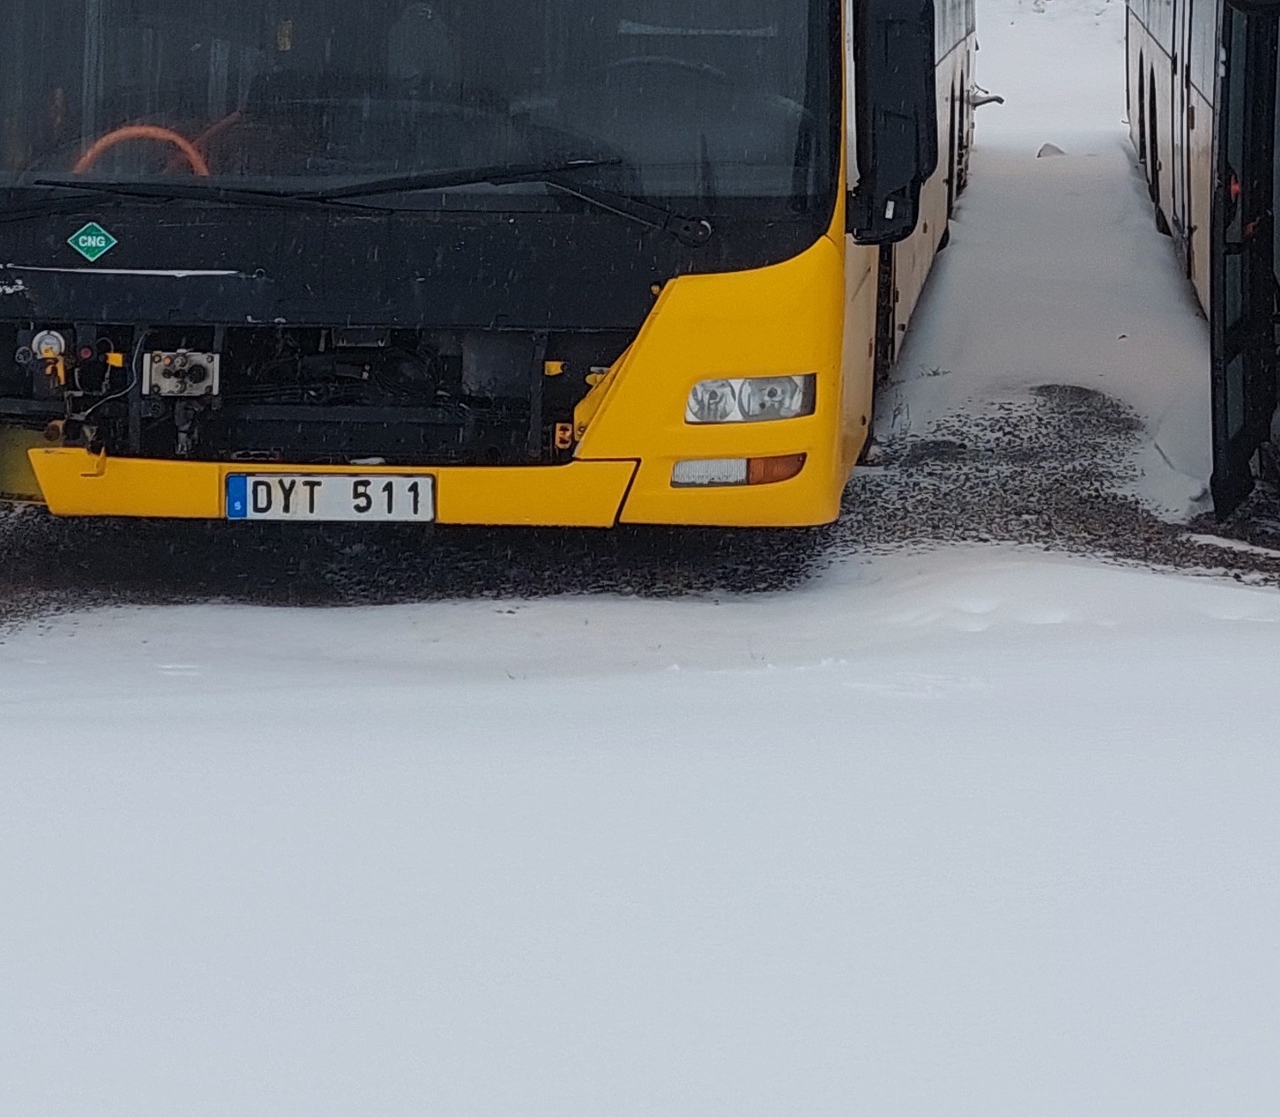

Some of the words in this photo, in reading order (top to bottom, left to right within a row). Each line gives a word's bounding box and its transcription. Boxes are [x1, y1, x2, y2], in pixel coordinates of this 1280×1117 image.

[78, 235, 106, 248] CNG
[252, 478, 323, 514] DYT
[352, 479, 419, 515] 511
